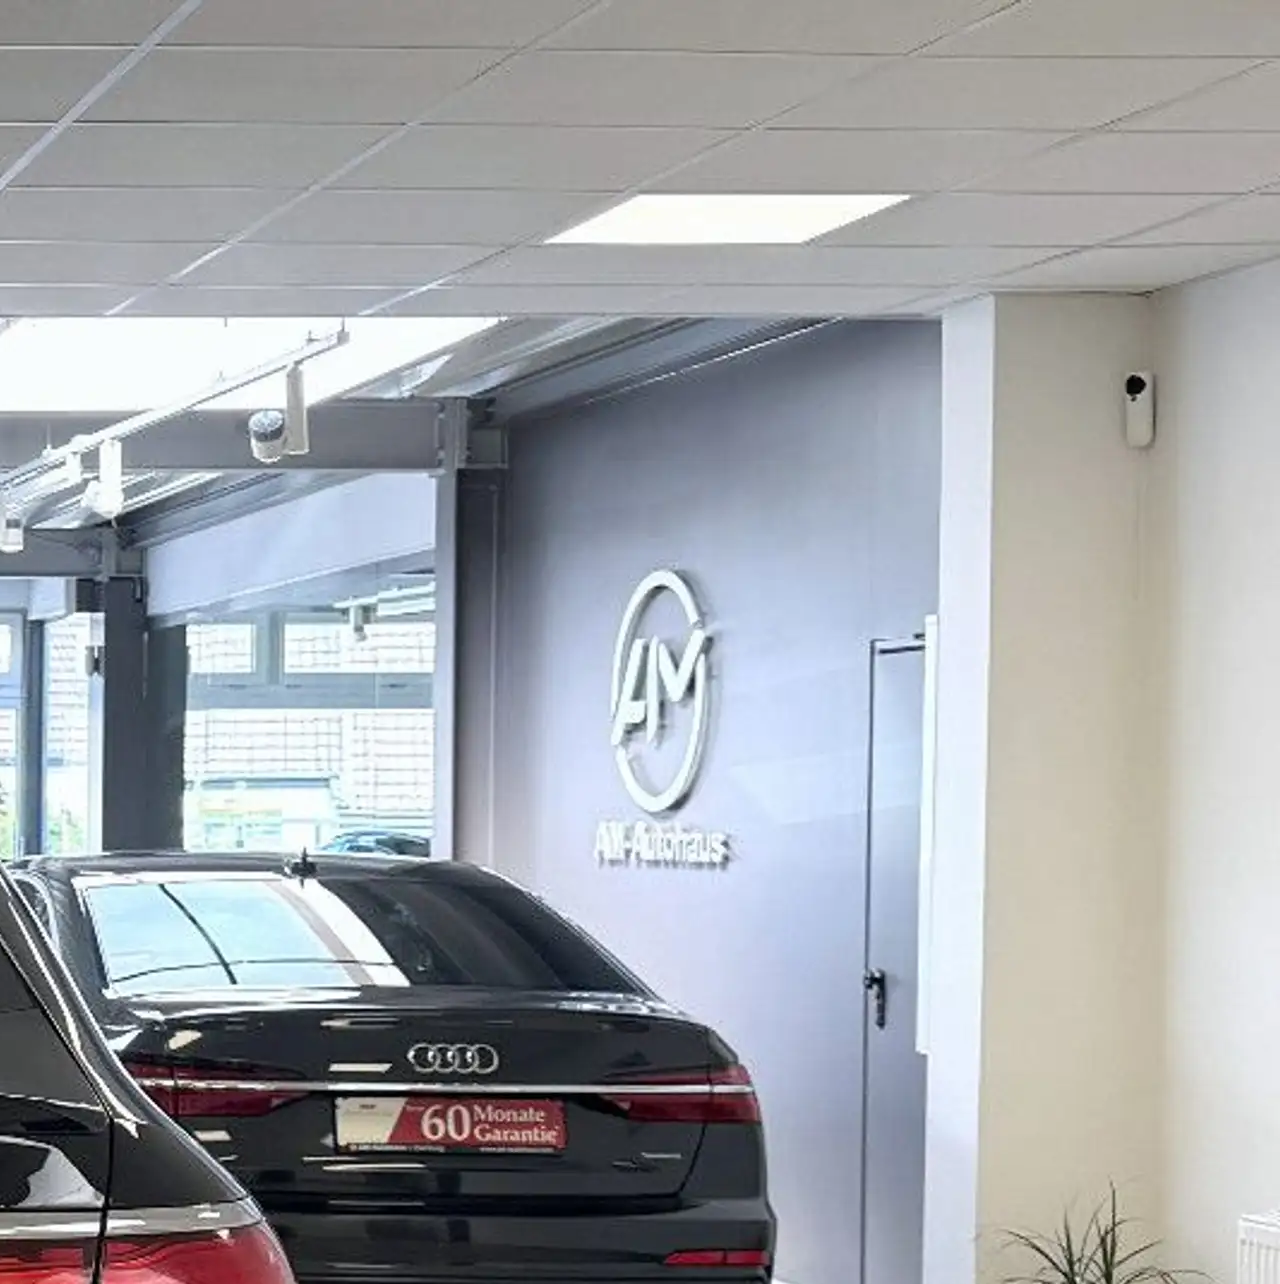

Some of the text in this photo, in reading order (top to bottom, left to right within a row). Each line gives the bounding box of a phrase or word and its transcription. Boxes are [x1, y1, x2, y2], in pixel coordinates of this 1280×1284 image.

[595, 819, 729, 864] AM-Autohaus
[420, 1104, 545, 1142] 60 Monate
